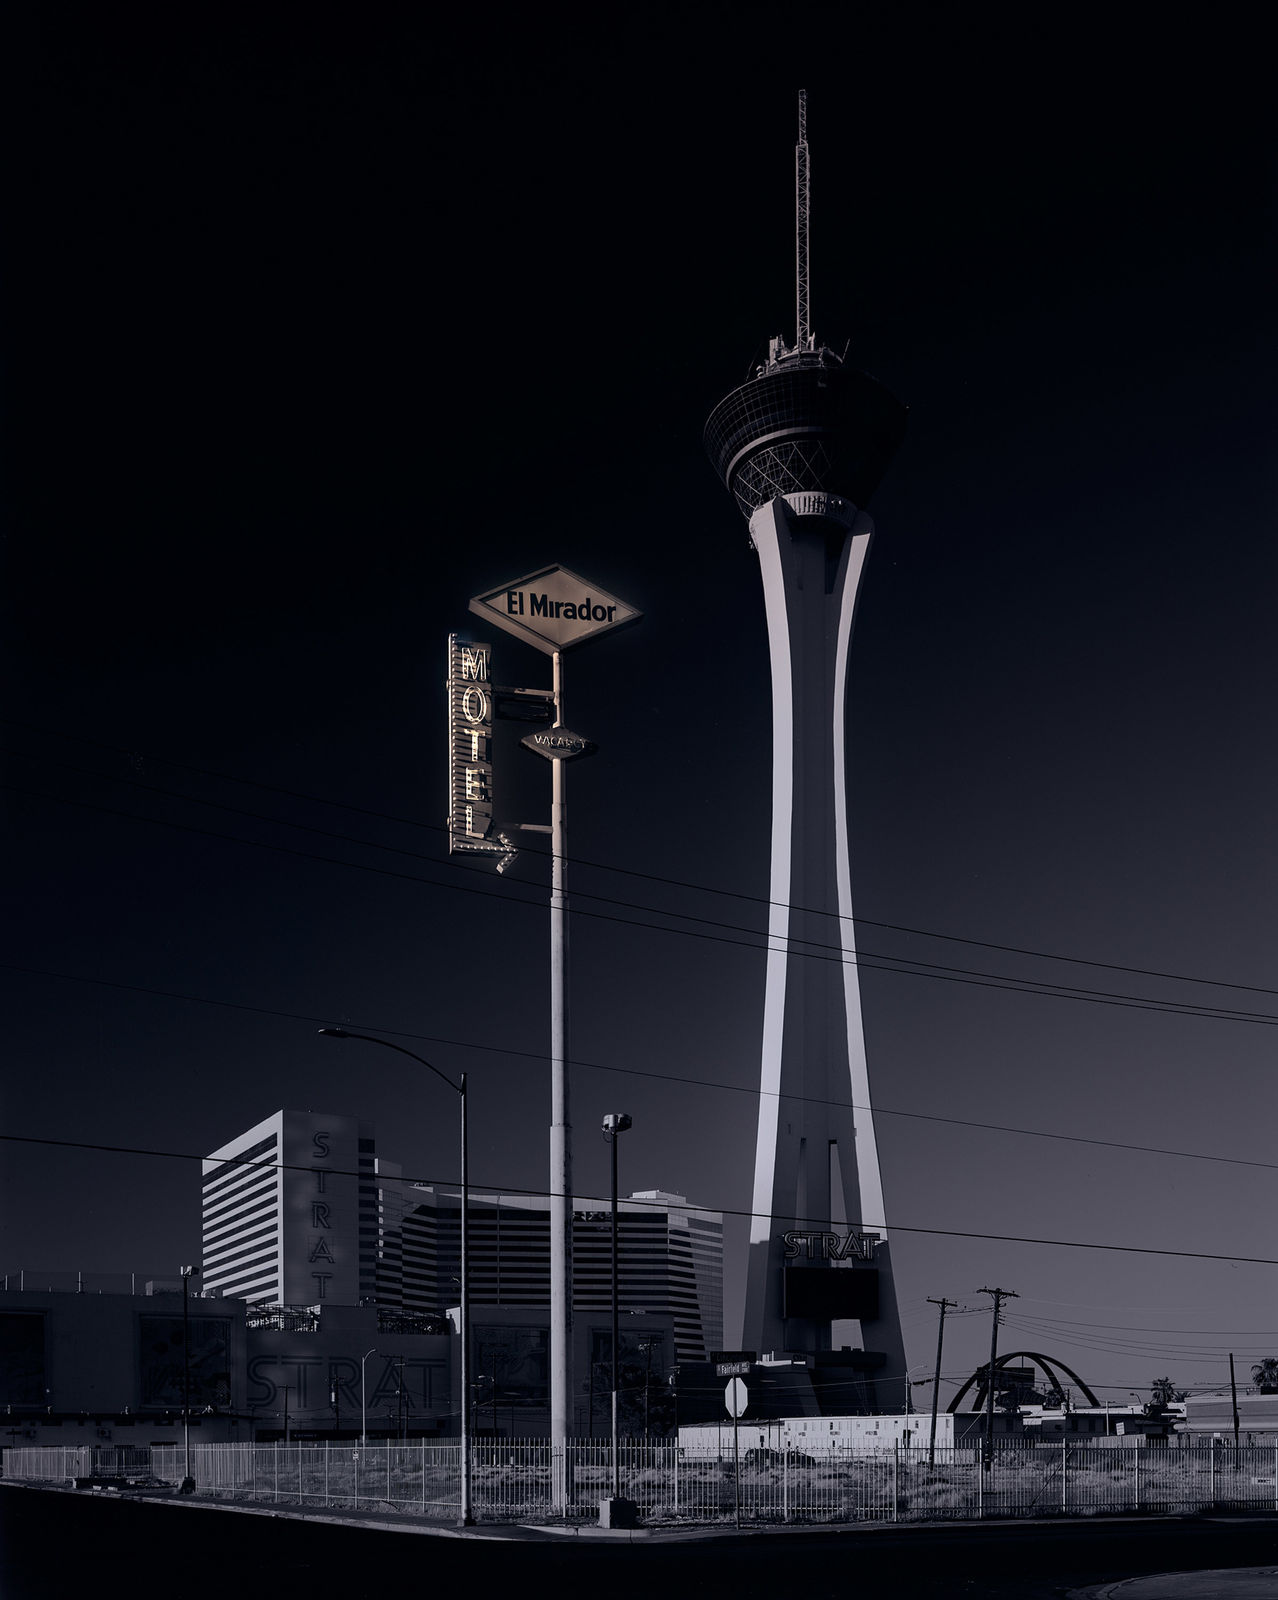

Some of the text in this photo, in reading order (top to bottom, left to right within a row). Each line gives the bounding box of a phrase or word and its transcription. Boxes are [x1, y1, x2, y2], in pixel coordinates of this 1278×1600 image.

[507, 590, 616, 622] El Mirador
[461, 648, 487, 838] MOTEL
[309, 1131, 335, 1298] STRAT
[784, 1231, 880, 1260] STRAT
[246, 1354, 447, 1409] STRAT
